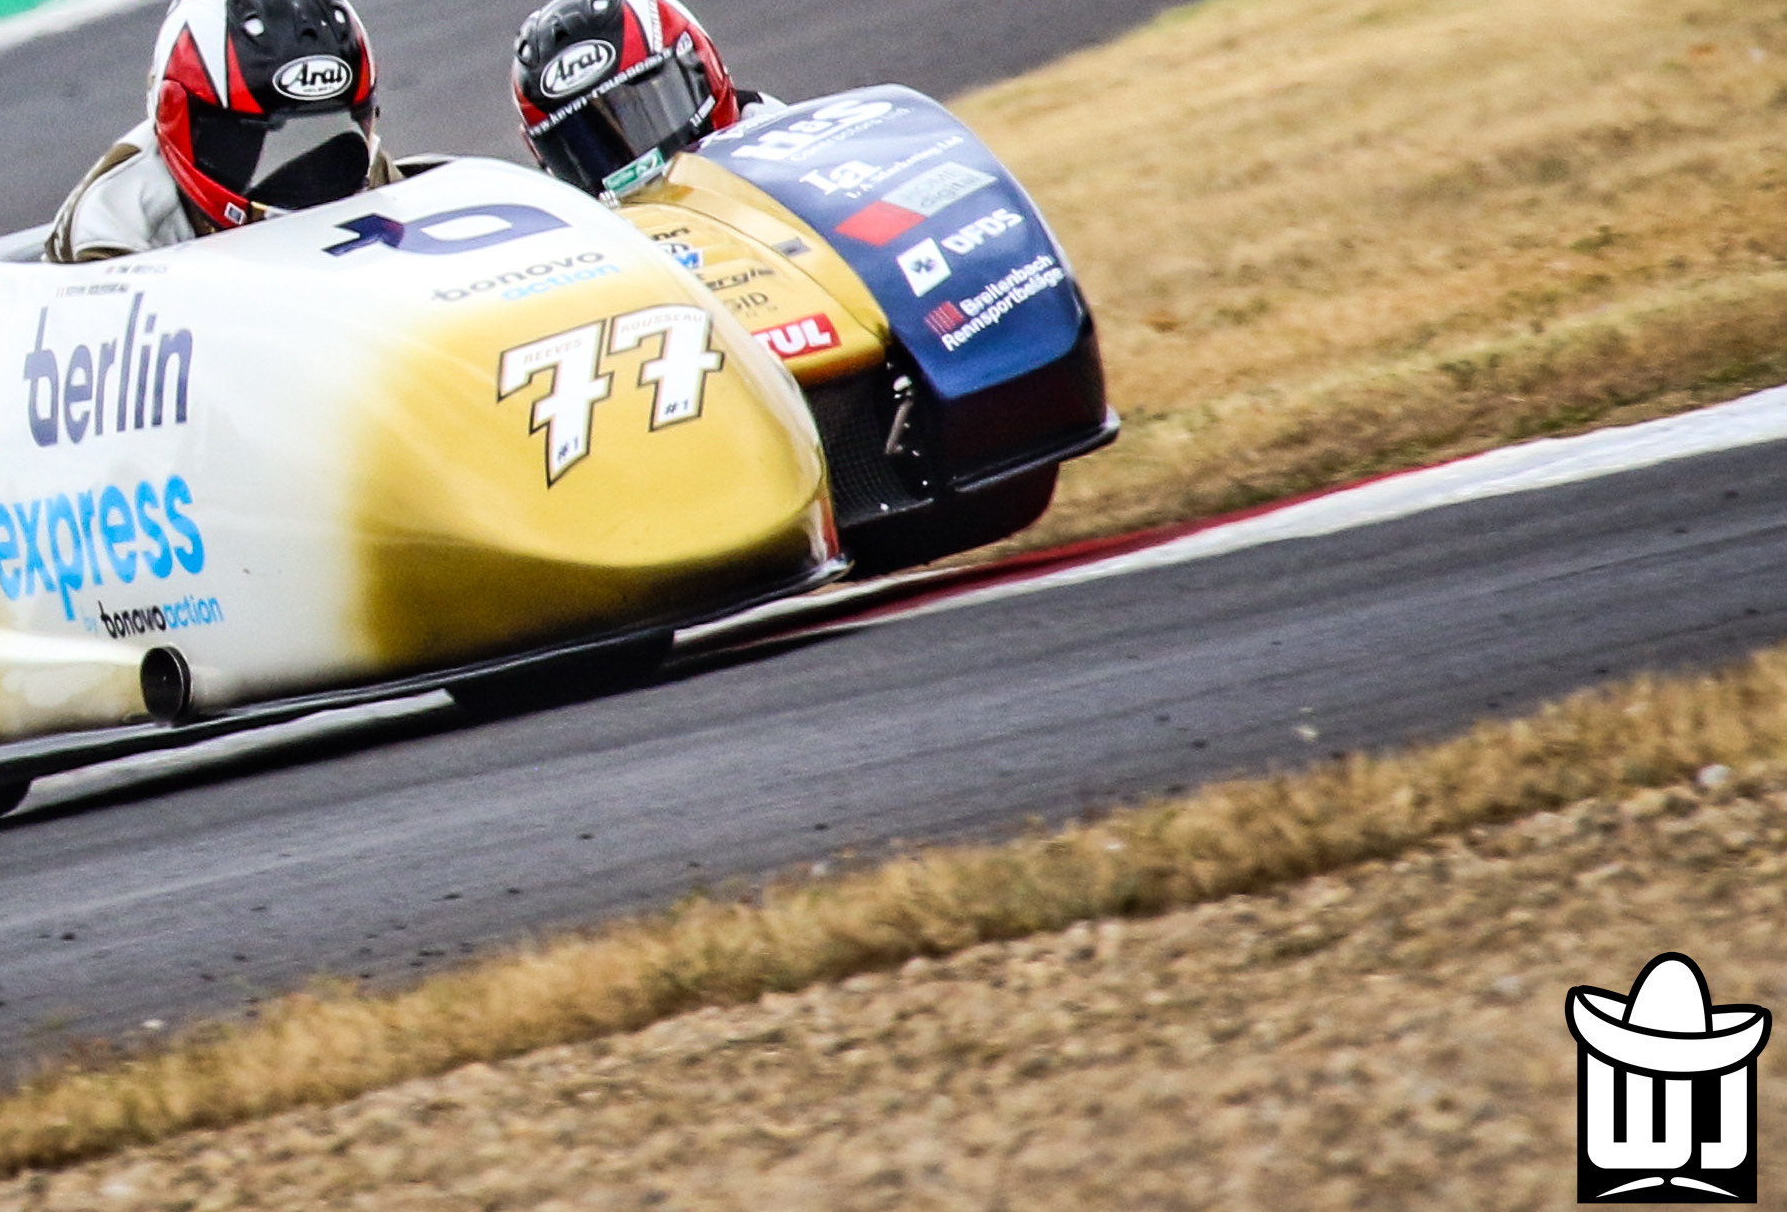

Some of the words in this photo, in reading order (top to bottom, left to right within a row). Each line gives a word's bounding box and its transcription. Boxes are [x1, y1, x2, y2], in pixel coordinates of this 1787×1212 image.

[281, 60, 344, 88] Arai
[940, 208, 1025, 256] DFDS
[431, 251, 605, 302] bonovo
[500, 262, 622, 301] action
[620, 312, 704, 335] ROUSSEAU
[752, 318, 832, 354] TUL
[23, 290, 193, 448] berlin
[523, 337, 583, 365] REEVES
[496, 303, 725, 490] 77
